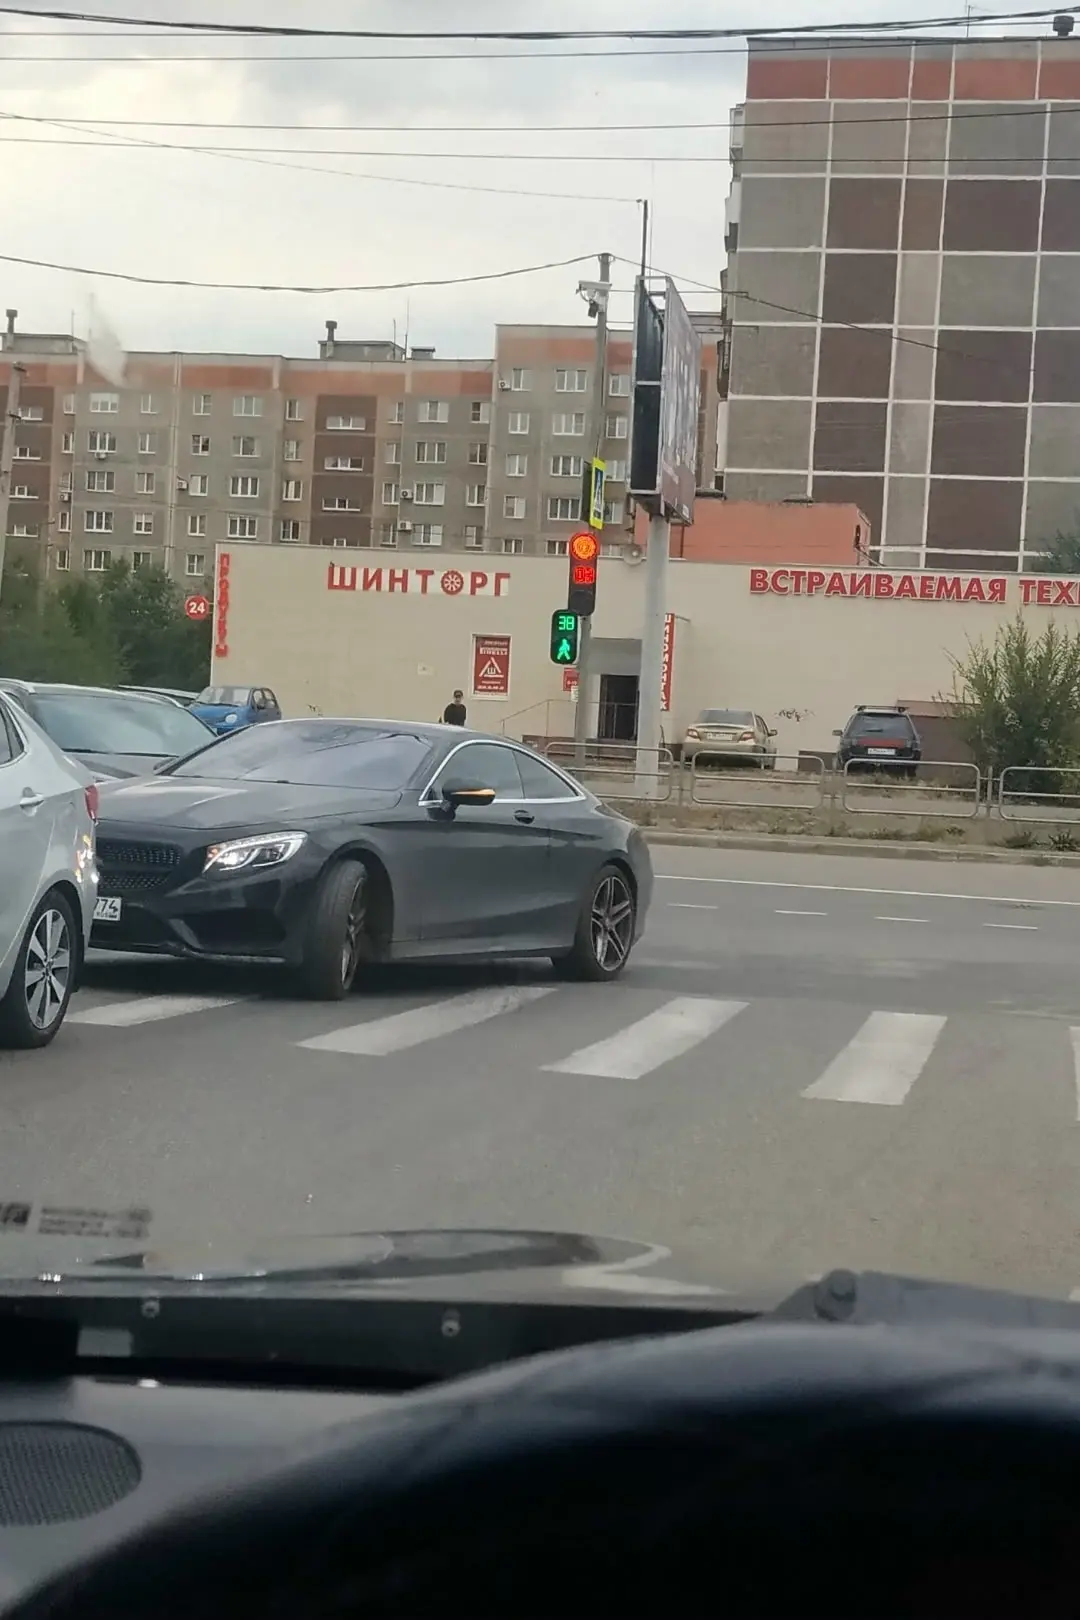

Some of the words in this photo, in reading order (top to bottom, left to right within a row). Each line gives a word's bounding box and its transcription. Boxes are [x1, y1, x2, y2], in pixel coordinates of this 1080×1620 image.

[327, 566, 511, 597] ШИНТОРГ
[750, 567, 1007, 603] ВСТРАИВАЕМАЯ
[1018, 578, 1080, 606] ТЕХ
[189, 601, 206, 614] 24
[558, 615, 575, 631] 38
